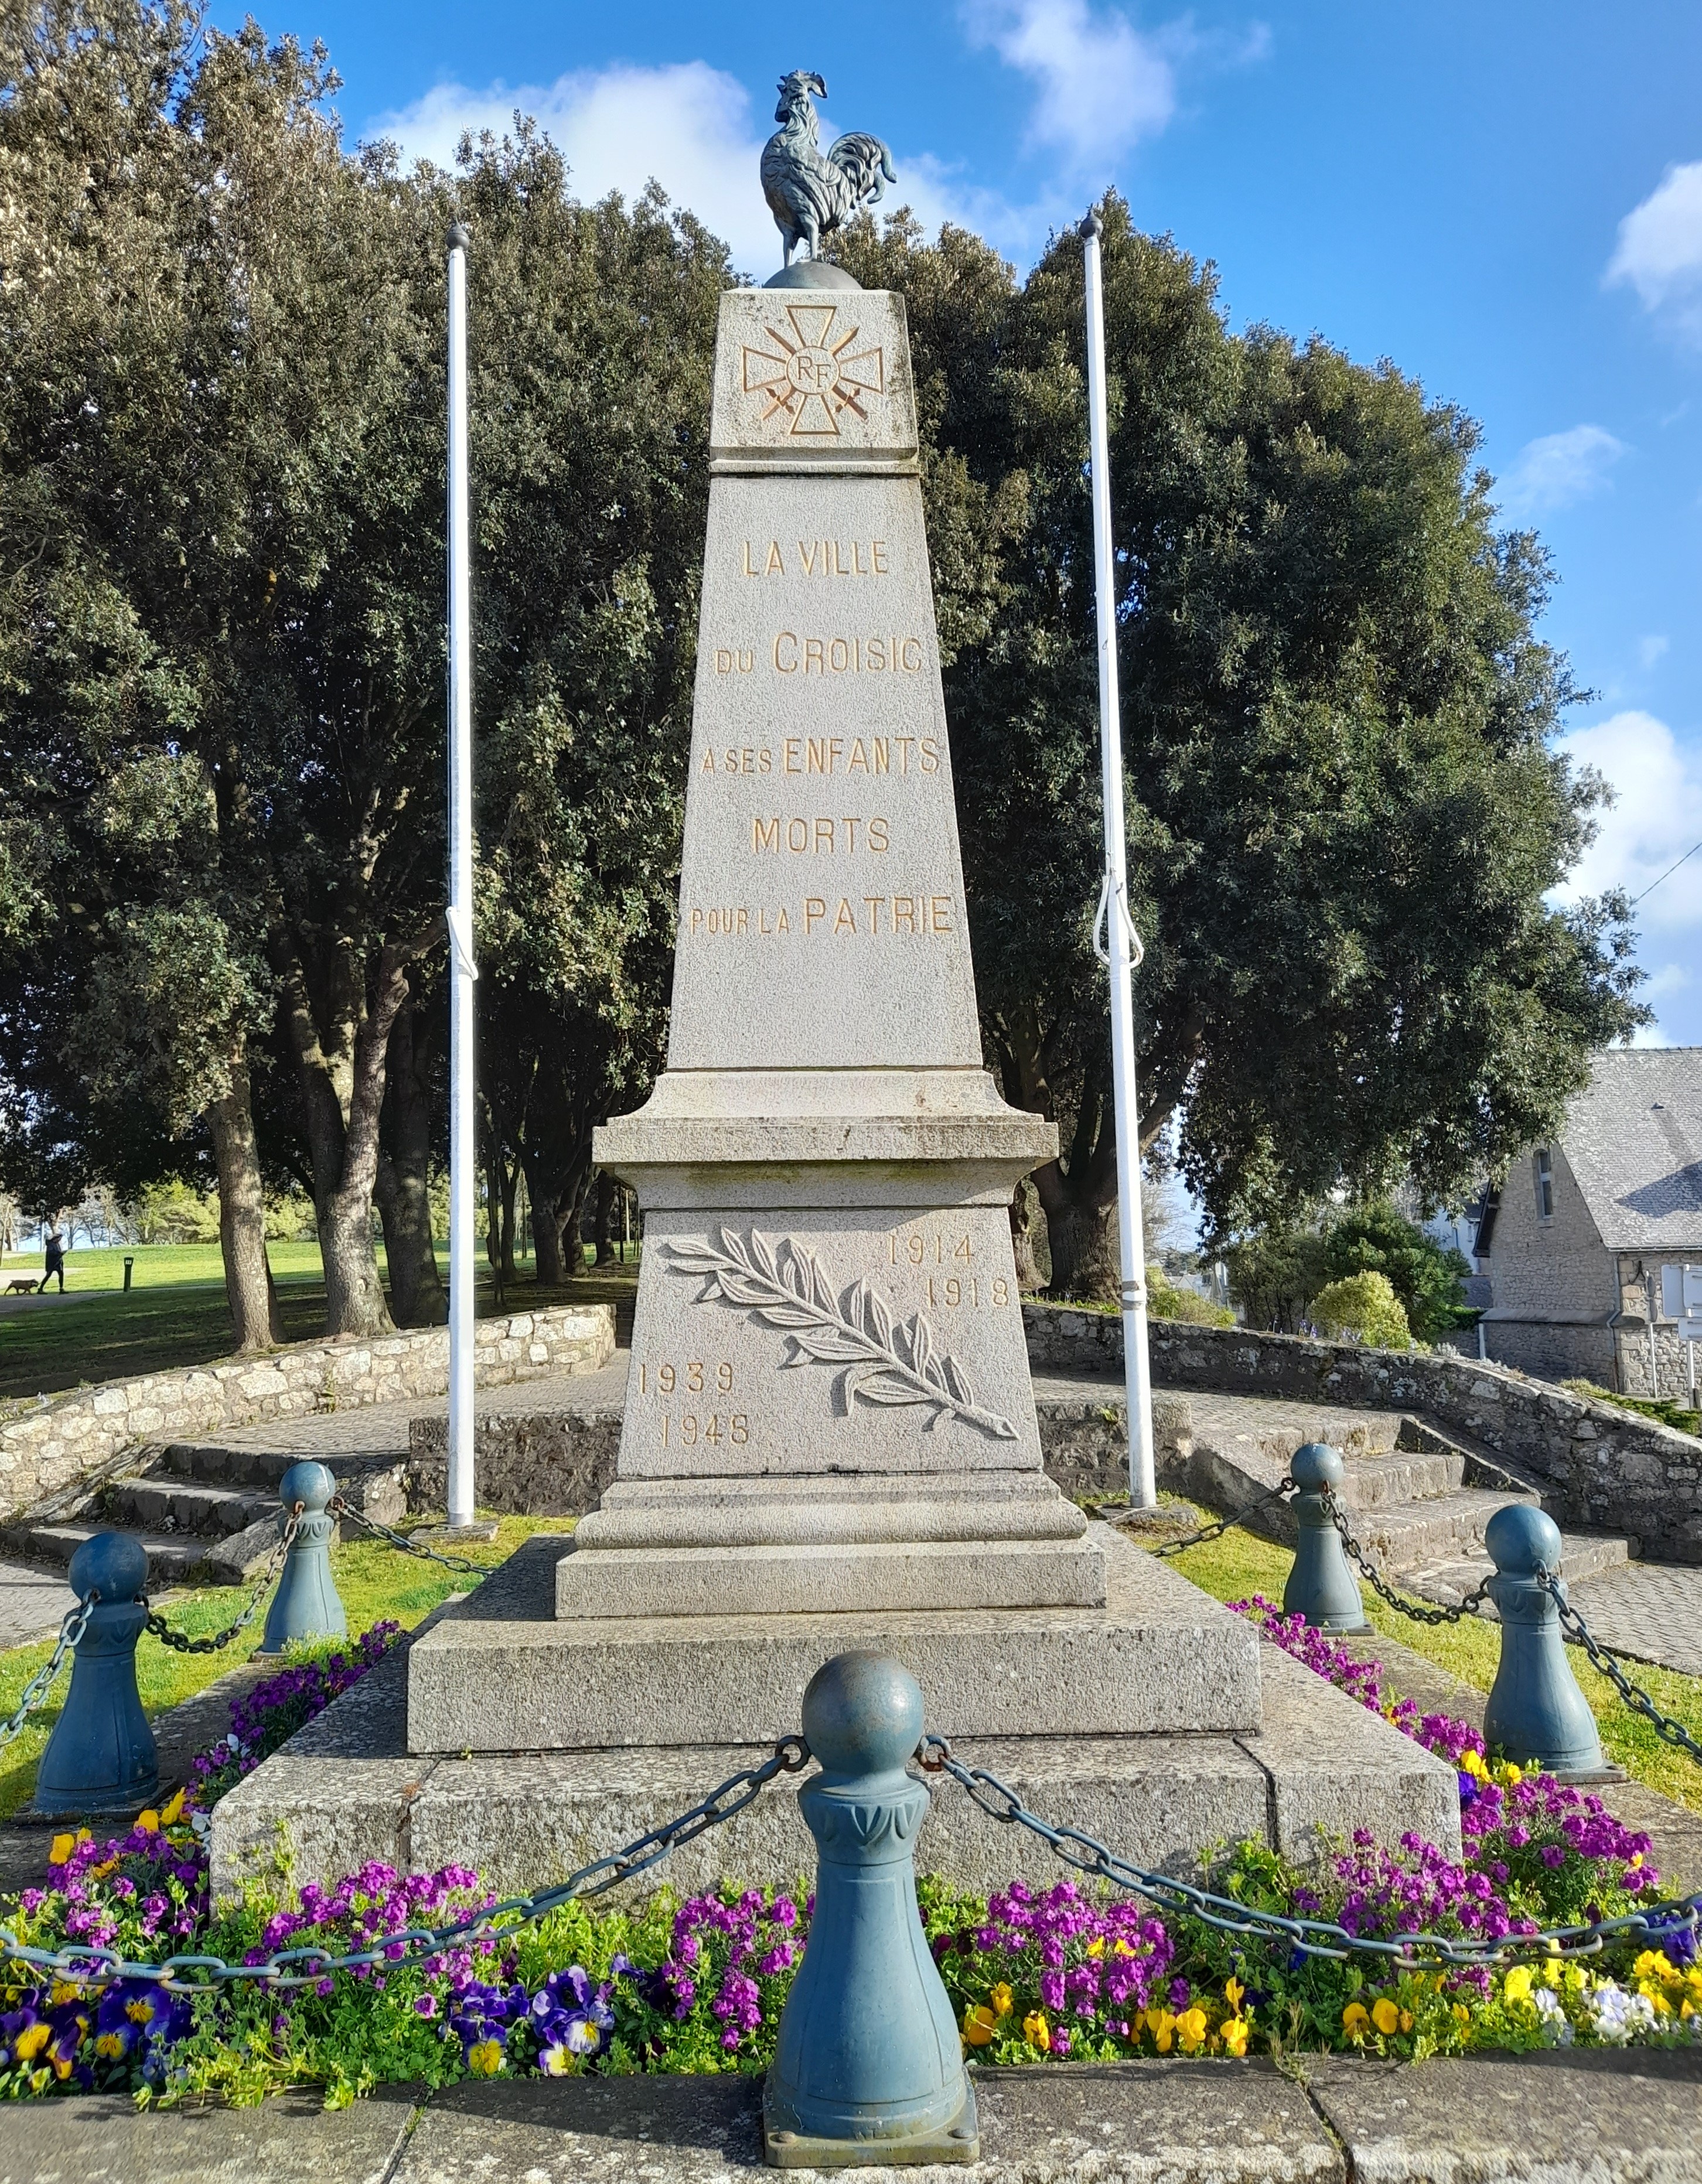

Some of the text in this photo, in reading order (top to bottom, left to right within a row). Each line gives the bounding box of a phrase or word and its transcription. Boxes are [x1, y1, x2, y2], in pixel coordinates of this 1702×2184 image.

[796, 356, 831, 388] RF
[743, 540, 888, 577] LA VILLE
[714, 632, 922, 675] DU CROISIC
[702, 737, 940, 775] A SES ENFANTS
[752, 817, 890, 855] MORTS
[690, 896, 953, 936] POUR LA PATRIE
[889, 1234, 974, 1265] 1914
[927, 1276, 1009, 1308] 1918
[639, 1362, 734, 1396] 1939
[661, 1414, 749, 1448] 1945
